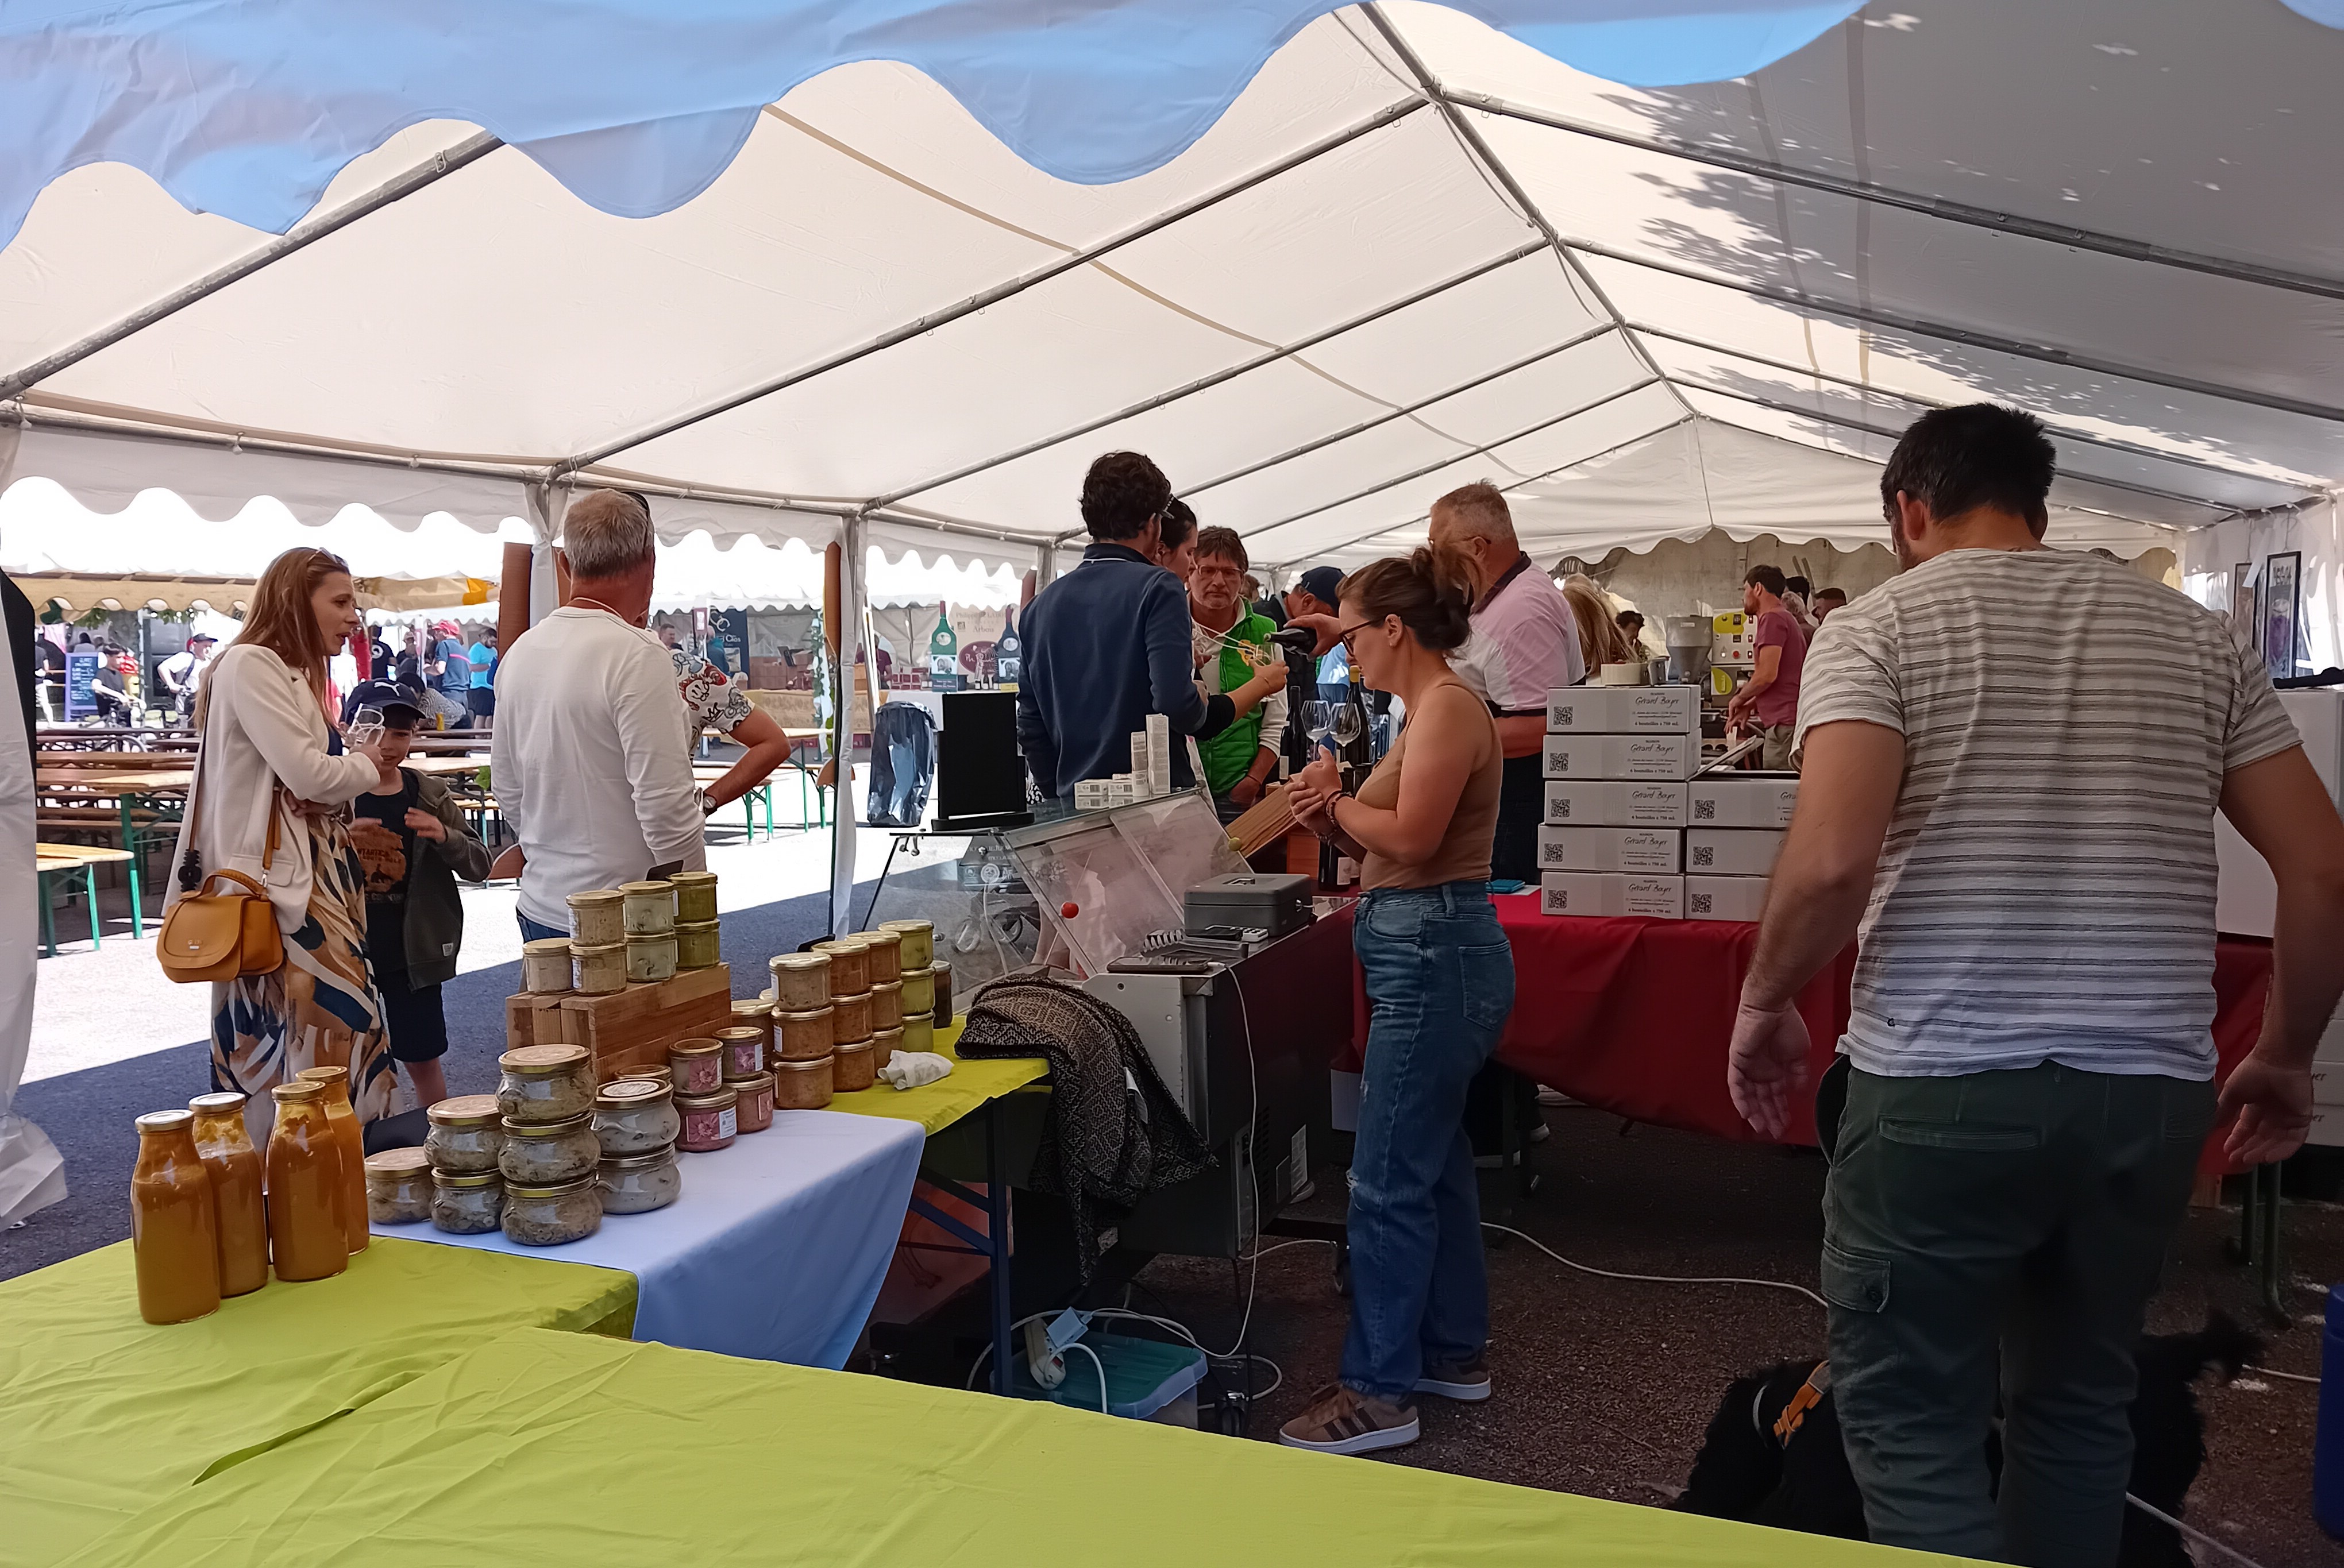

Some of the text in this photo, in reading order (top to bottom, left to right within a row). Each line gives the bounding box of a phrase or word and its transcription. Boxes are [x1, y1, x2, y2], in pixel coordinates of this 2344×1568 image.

[1660, 696, 1679, 708] Boyer
[1655, 743, 1674, 756] Boyer
[1657, 790, 1676, 803] Boyer
[1649, 836, 1668, 849] Boyer
[1653, 883, 1672, 896] Boyer
